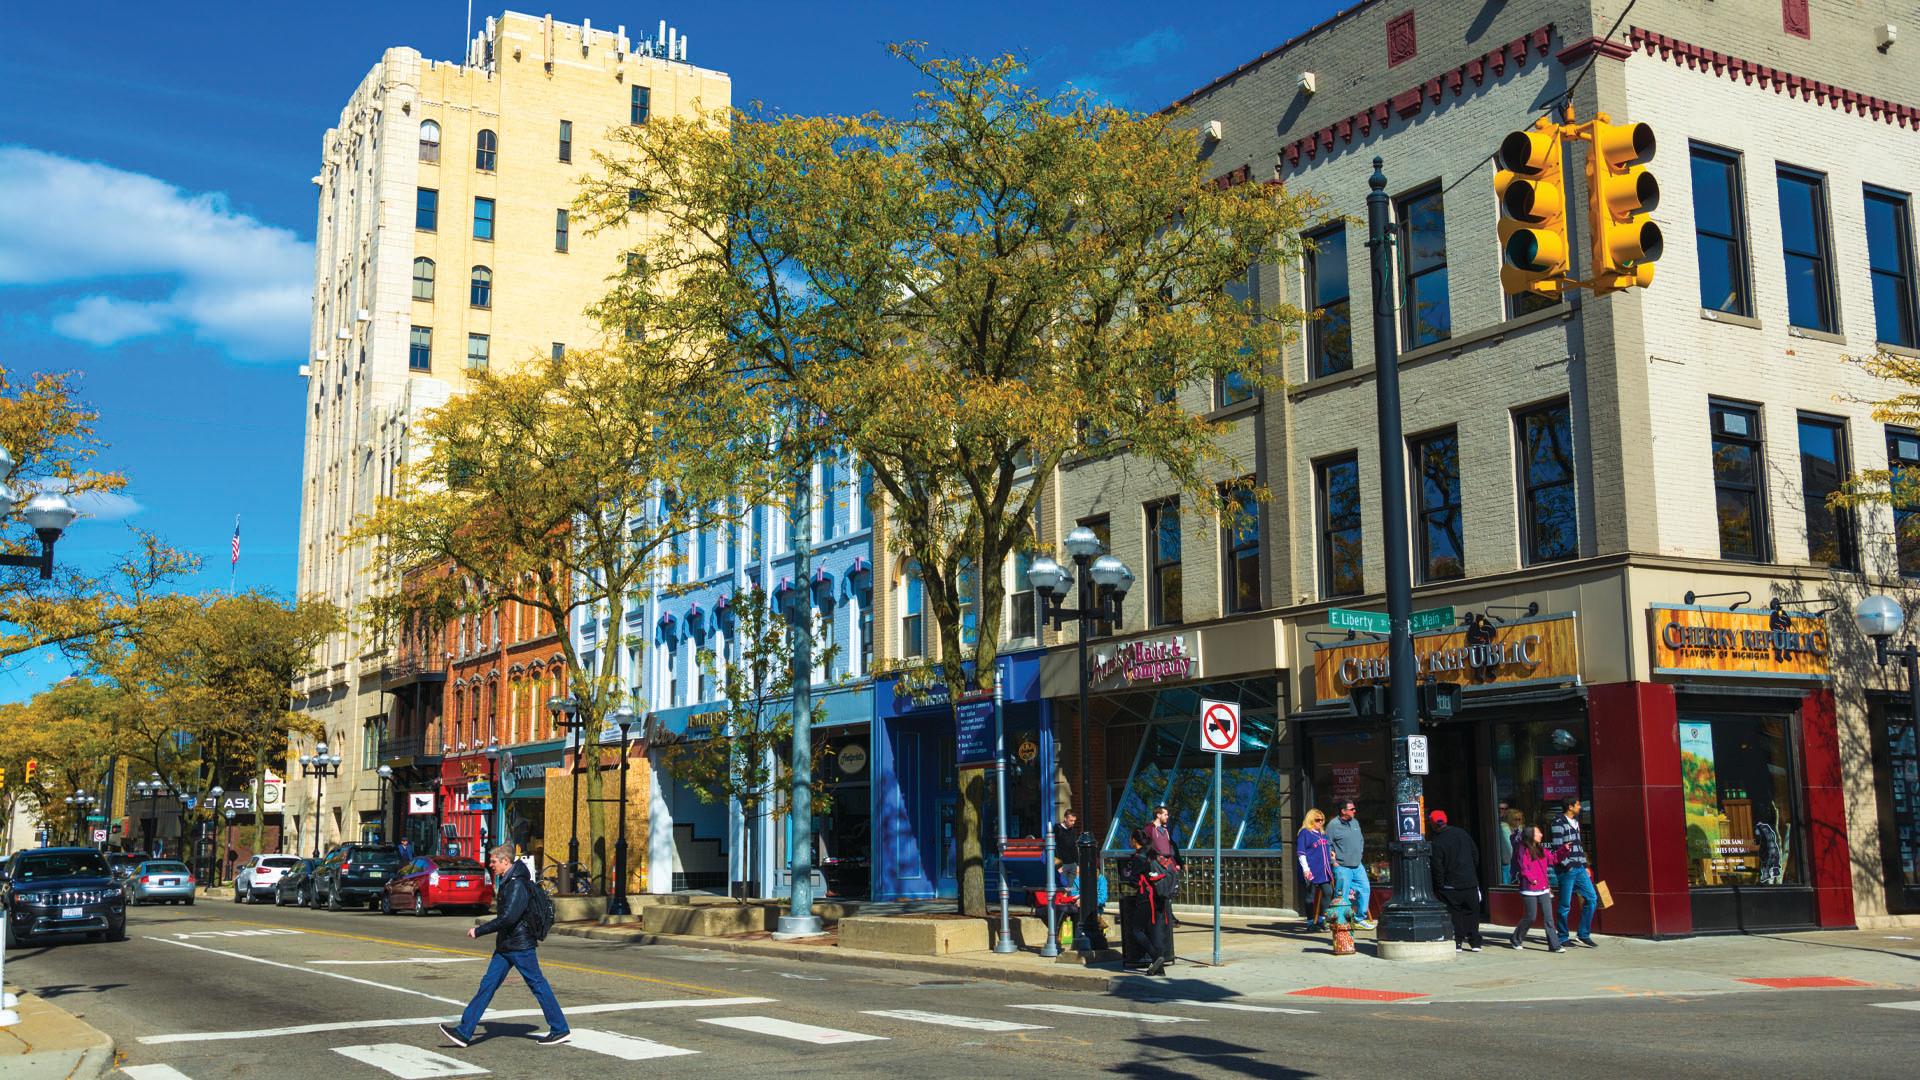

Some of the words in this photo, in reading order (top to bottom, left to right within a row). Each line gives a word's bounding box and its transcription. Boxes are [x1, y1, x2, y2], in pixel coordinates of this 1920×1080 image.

[1332, 612, 1340, 624] E.
[1341, 613, 1373, 632] Liberty
[1413, 616, 1421, 628] S.
[1422, 614, 1440, 626] Main
[1135, 641, 1167, 663] Hair
[1171, 635, 1182, 657] &
[1664, 622, 1738, 651] CHERRY
[1743, 630, 1828, 656] REPUBLIC
[1340, 656, 1423, 684] CHEY
[1430, 635, 1542, 673] REPUBLIC
[1680, 649, 1716, 659] FLAVORS
[1719, 651, 1728, 660] OF
[1732, 651, 1770, 660] MICHIGAN
[1123, 657, 1191, 683] Company
